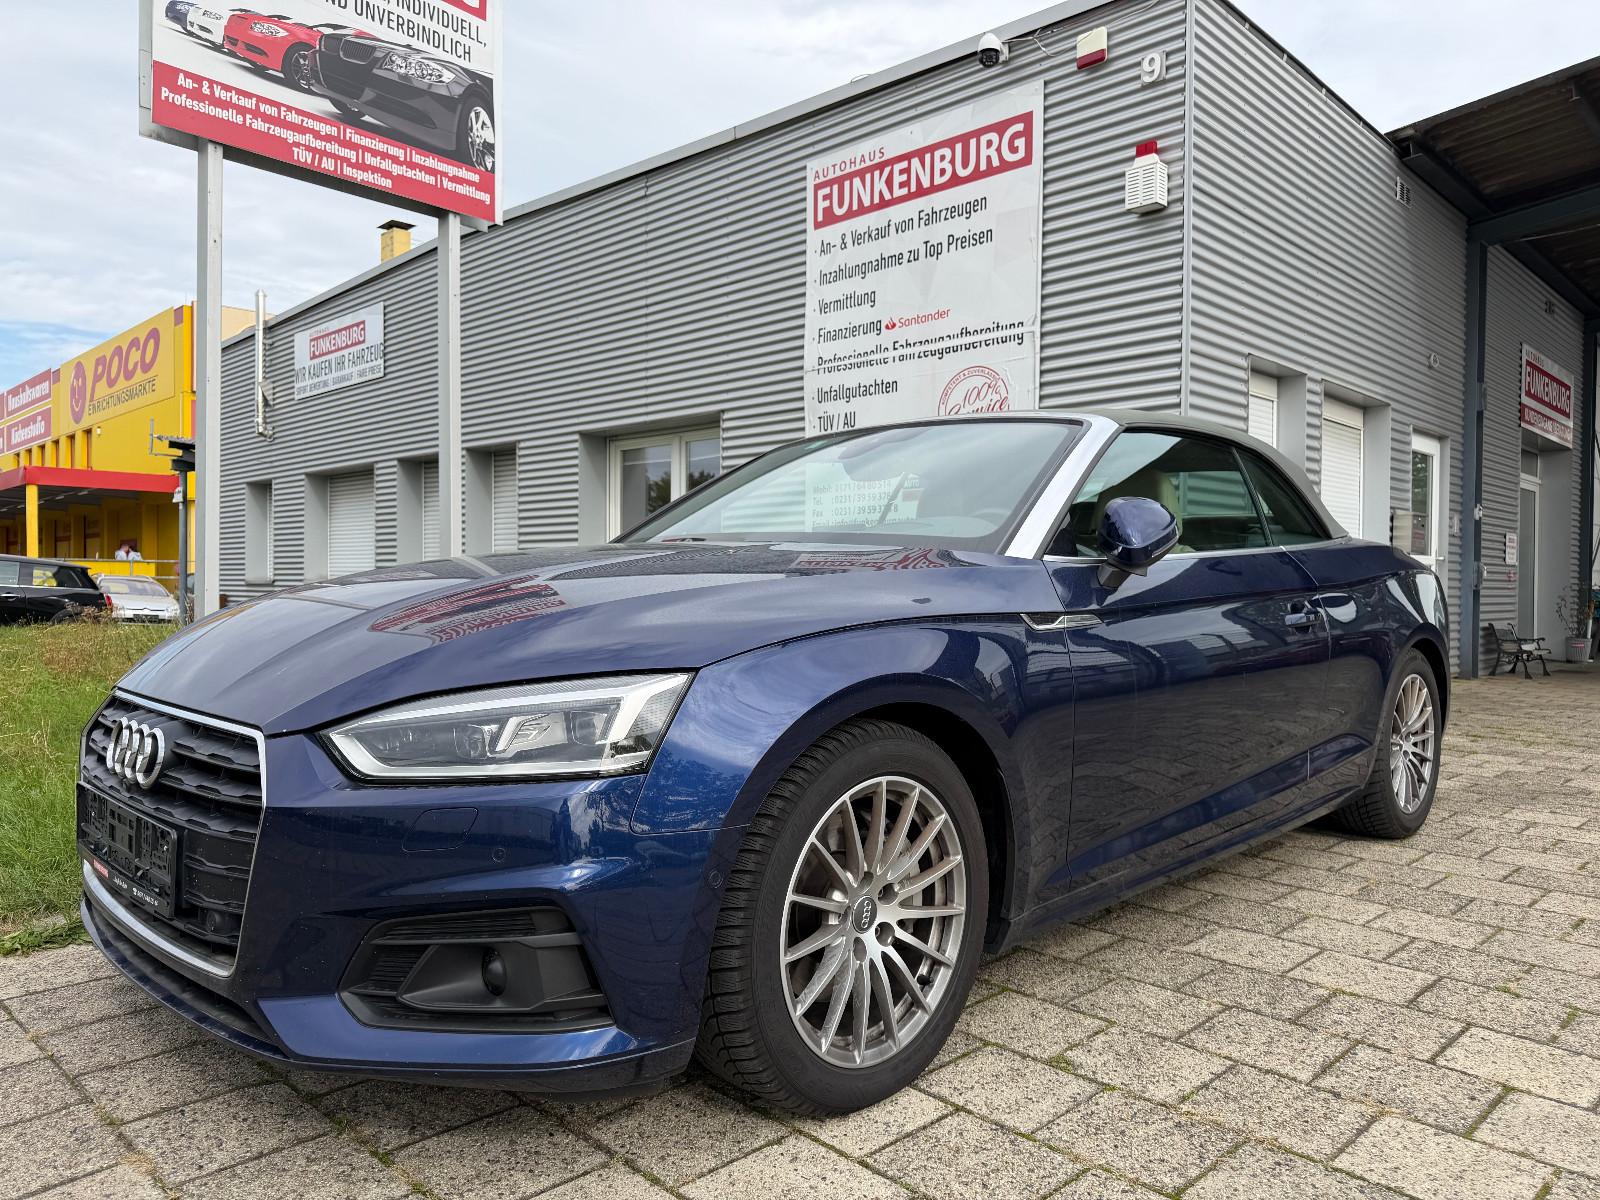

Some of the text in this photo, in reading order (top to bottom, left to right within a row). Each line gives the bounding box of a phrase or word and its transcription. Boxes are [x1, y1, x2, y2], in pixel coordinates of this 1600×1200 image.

[354, 0, 471, 62] UNVERBINDLICH
[1142, 52, 1162, 83] 9
[161, 87, 243, 124] Professionelle
[246, 115, 356, 163] Fahrzeugaufbereitung
[364, 152, 435, 186] Unfallgutachten
[442, 176, 490, 204] Vermittlung
[177, 73, 198, 89] An-
[202, 81, 210, 95] &
[213, 84, 256, 109] Verkauf
[259, 102, 278, 117] von
[281, 107, 337, 137] Fahrzeugen
[346, 128, 404, 161] Finanzierung
[412, 150, 480, 183] Inzahlungnahme
[292, 146, 313, 164] TÜV
[321, 157, 334, 171] AU
[343, 162, 392, 188] Inspektion
[813, 146, 885, 181] AUTOHAUS
[817, 123, 1025, 222] FUNKENBURG
[820, 196, 987, 256] An- & Verkauf von Fahrzeugen
[820, 228, 993, 287] Inzahlungnahme zu Top Preisen
[818, 290, 876, 315] Vermittlung
[310, 324, 364, 358] FUNKENBURG
[817, 309, 951, 344] Finanzierung Santander
[90, 327, 160, 402] POCO
[308, 359, 332, 380] KAUFEN
[334, 354, 346, 373] IHR
[348, 342, 384, 368] FAHRZEUG
[817, 378, 898, 404] Unfallgutachten
[963, 380, 1002, 408] 100%
[1525, 365, 1570, 414] FUNKENBURG
[818, 414, 835, 432] TÜV
[843, 411, 856, 429] AU
